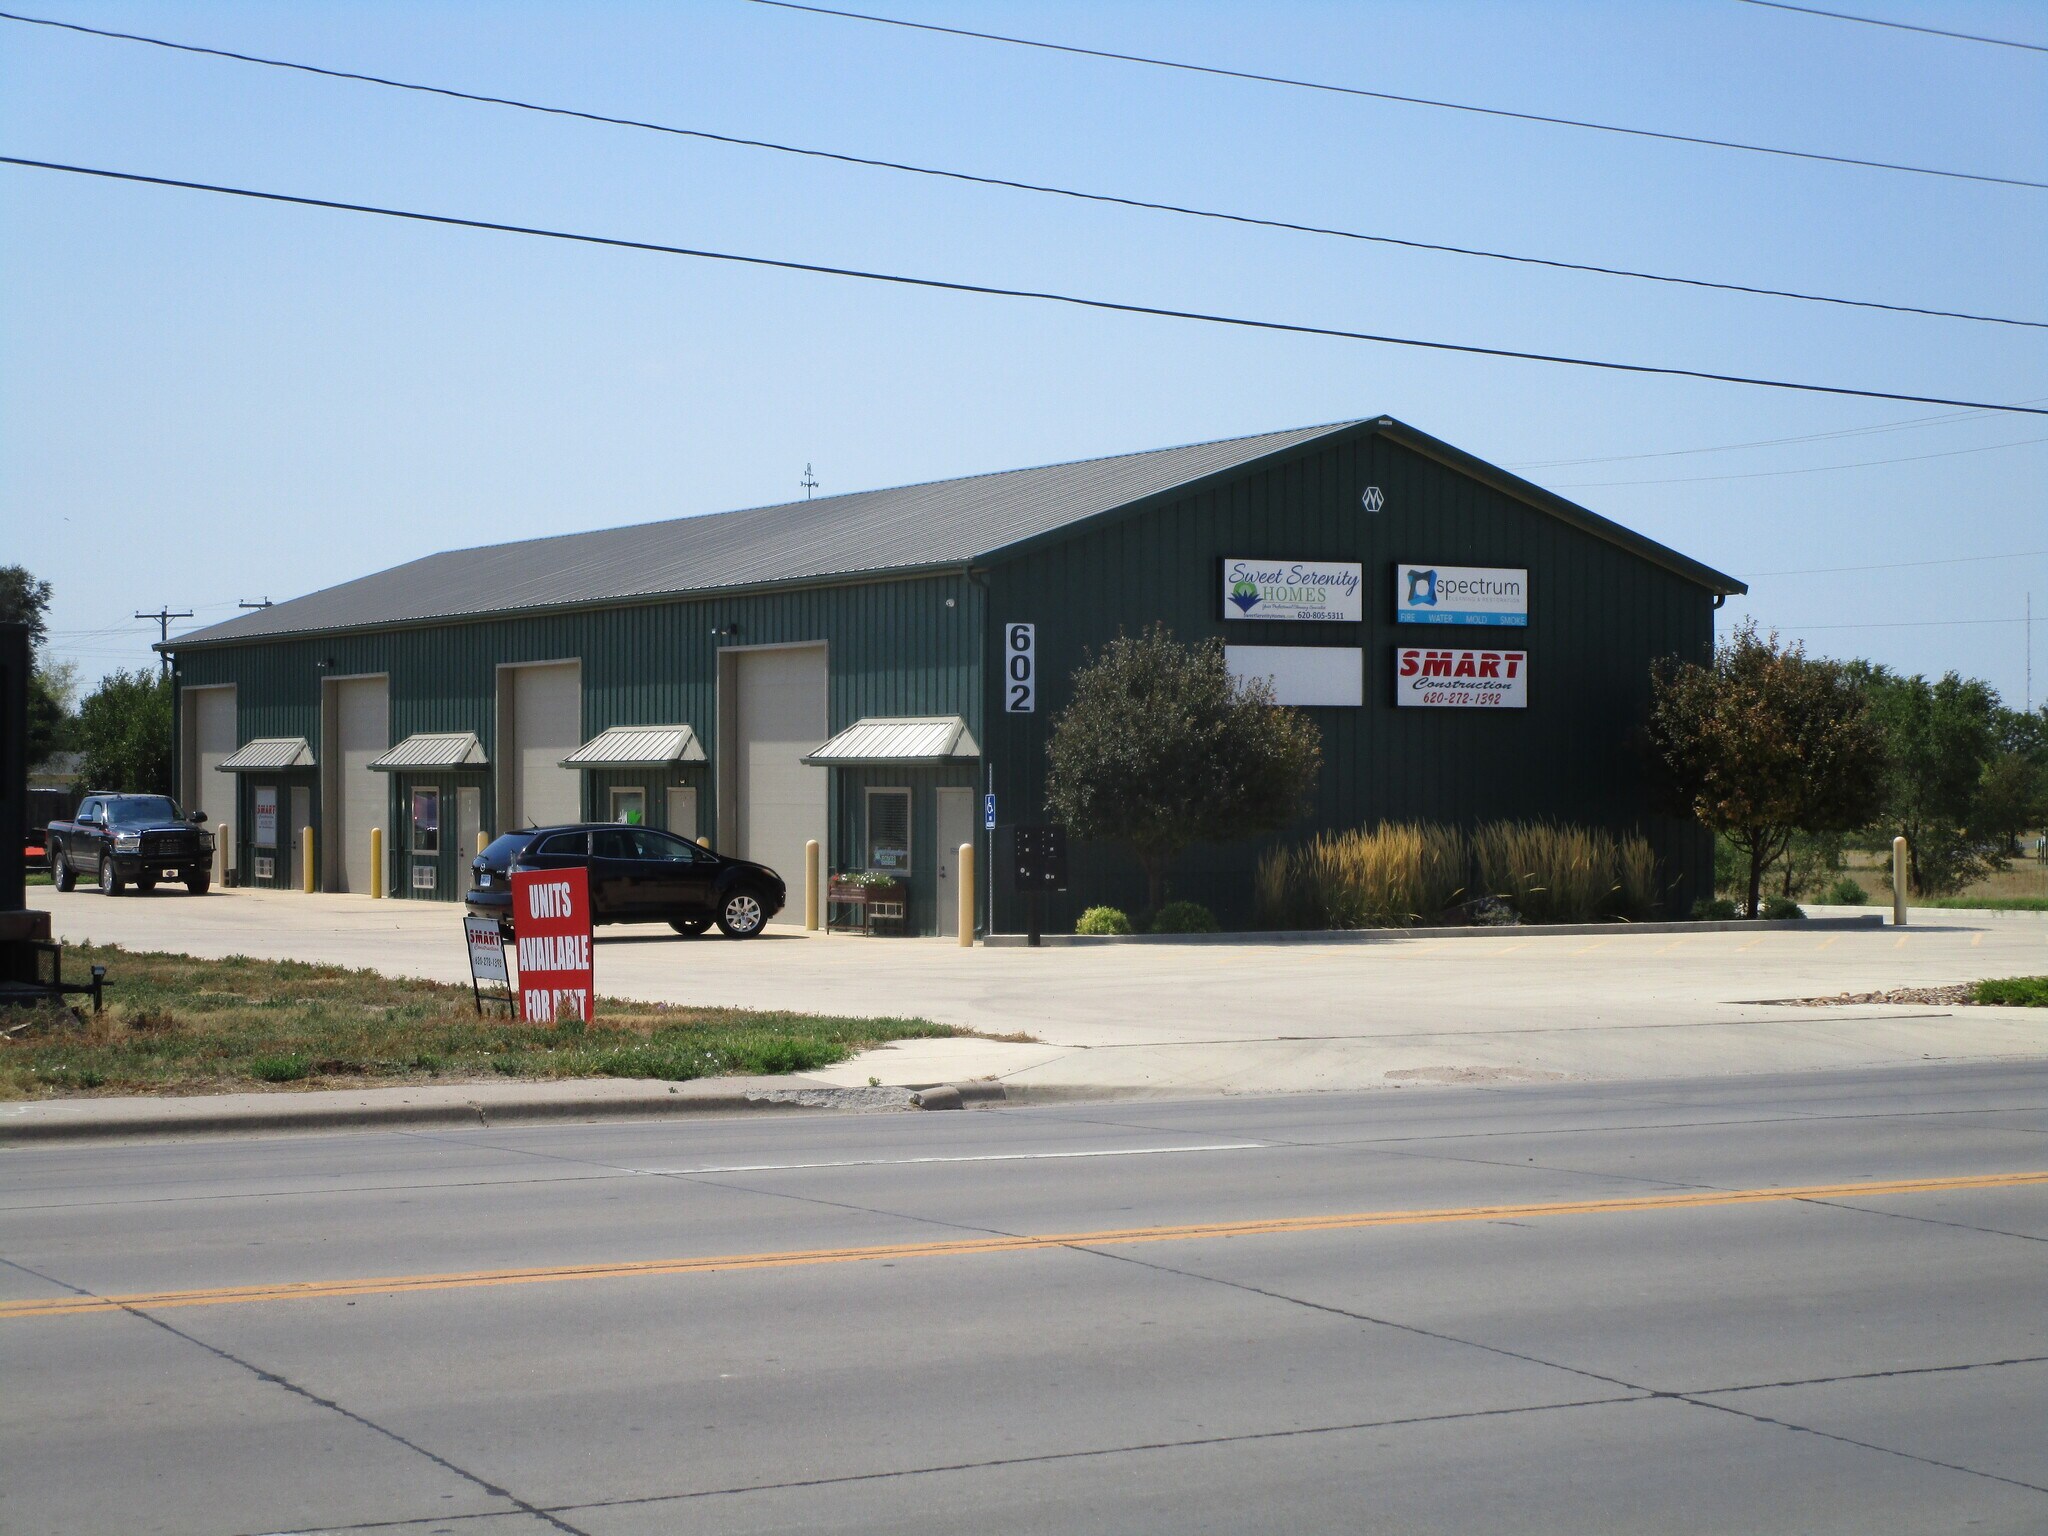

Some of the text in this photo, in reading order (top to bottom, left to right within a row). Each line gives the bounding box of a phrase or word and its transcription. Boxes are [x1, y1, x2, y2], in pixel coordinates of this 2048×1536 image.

[1229, 563, 1360, 597] Sweet Serenity
[1436, 579, 1520, 600] spectrum
[1263, 586, 1326, 602] HOMES
[1297, 611, 1344, 620] 620-805-5311
[1400, 613, 1525, 625] FIRE WATER MOLD SMOKE
[1010, 625, 1031, 711] 602
[1400, 650, 1524, 678] SMART
[1412, 677, 1512, 690] Construction
[1423, 692, 1502, 705] 620-272-1392
[528, 881, 572, 920] UNITS
[470, 929, 500, 946] SMART
[519, 934, 590, 972] AVAILABLE
[524, 988, 551, 1024] FOR
